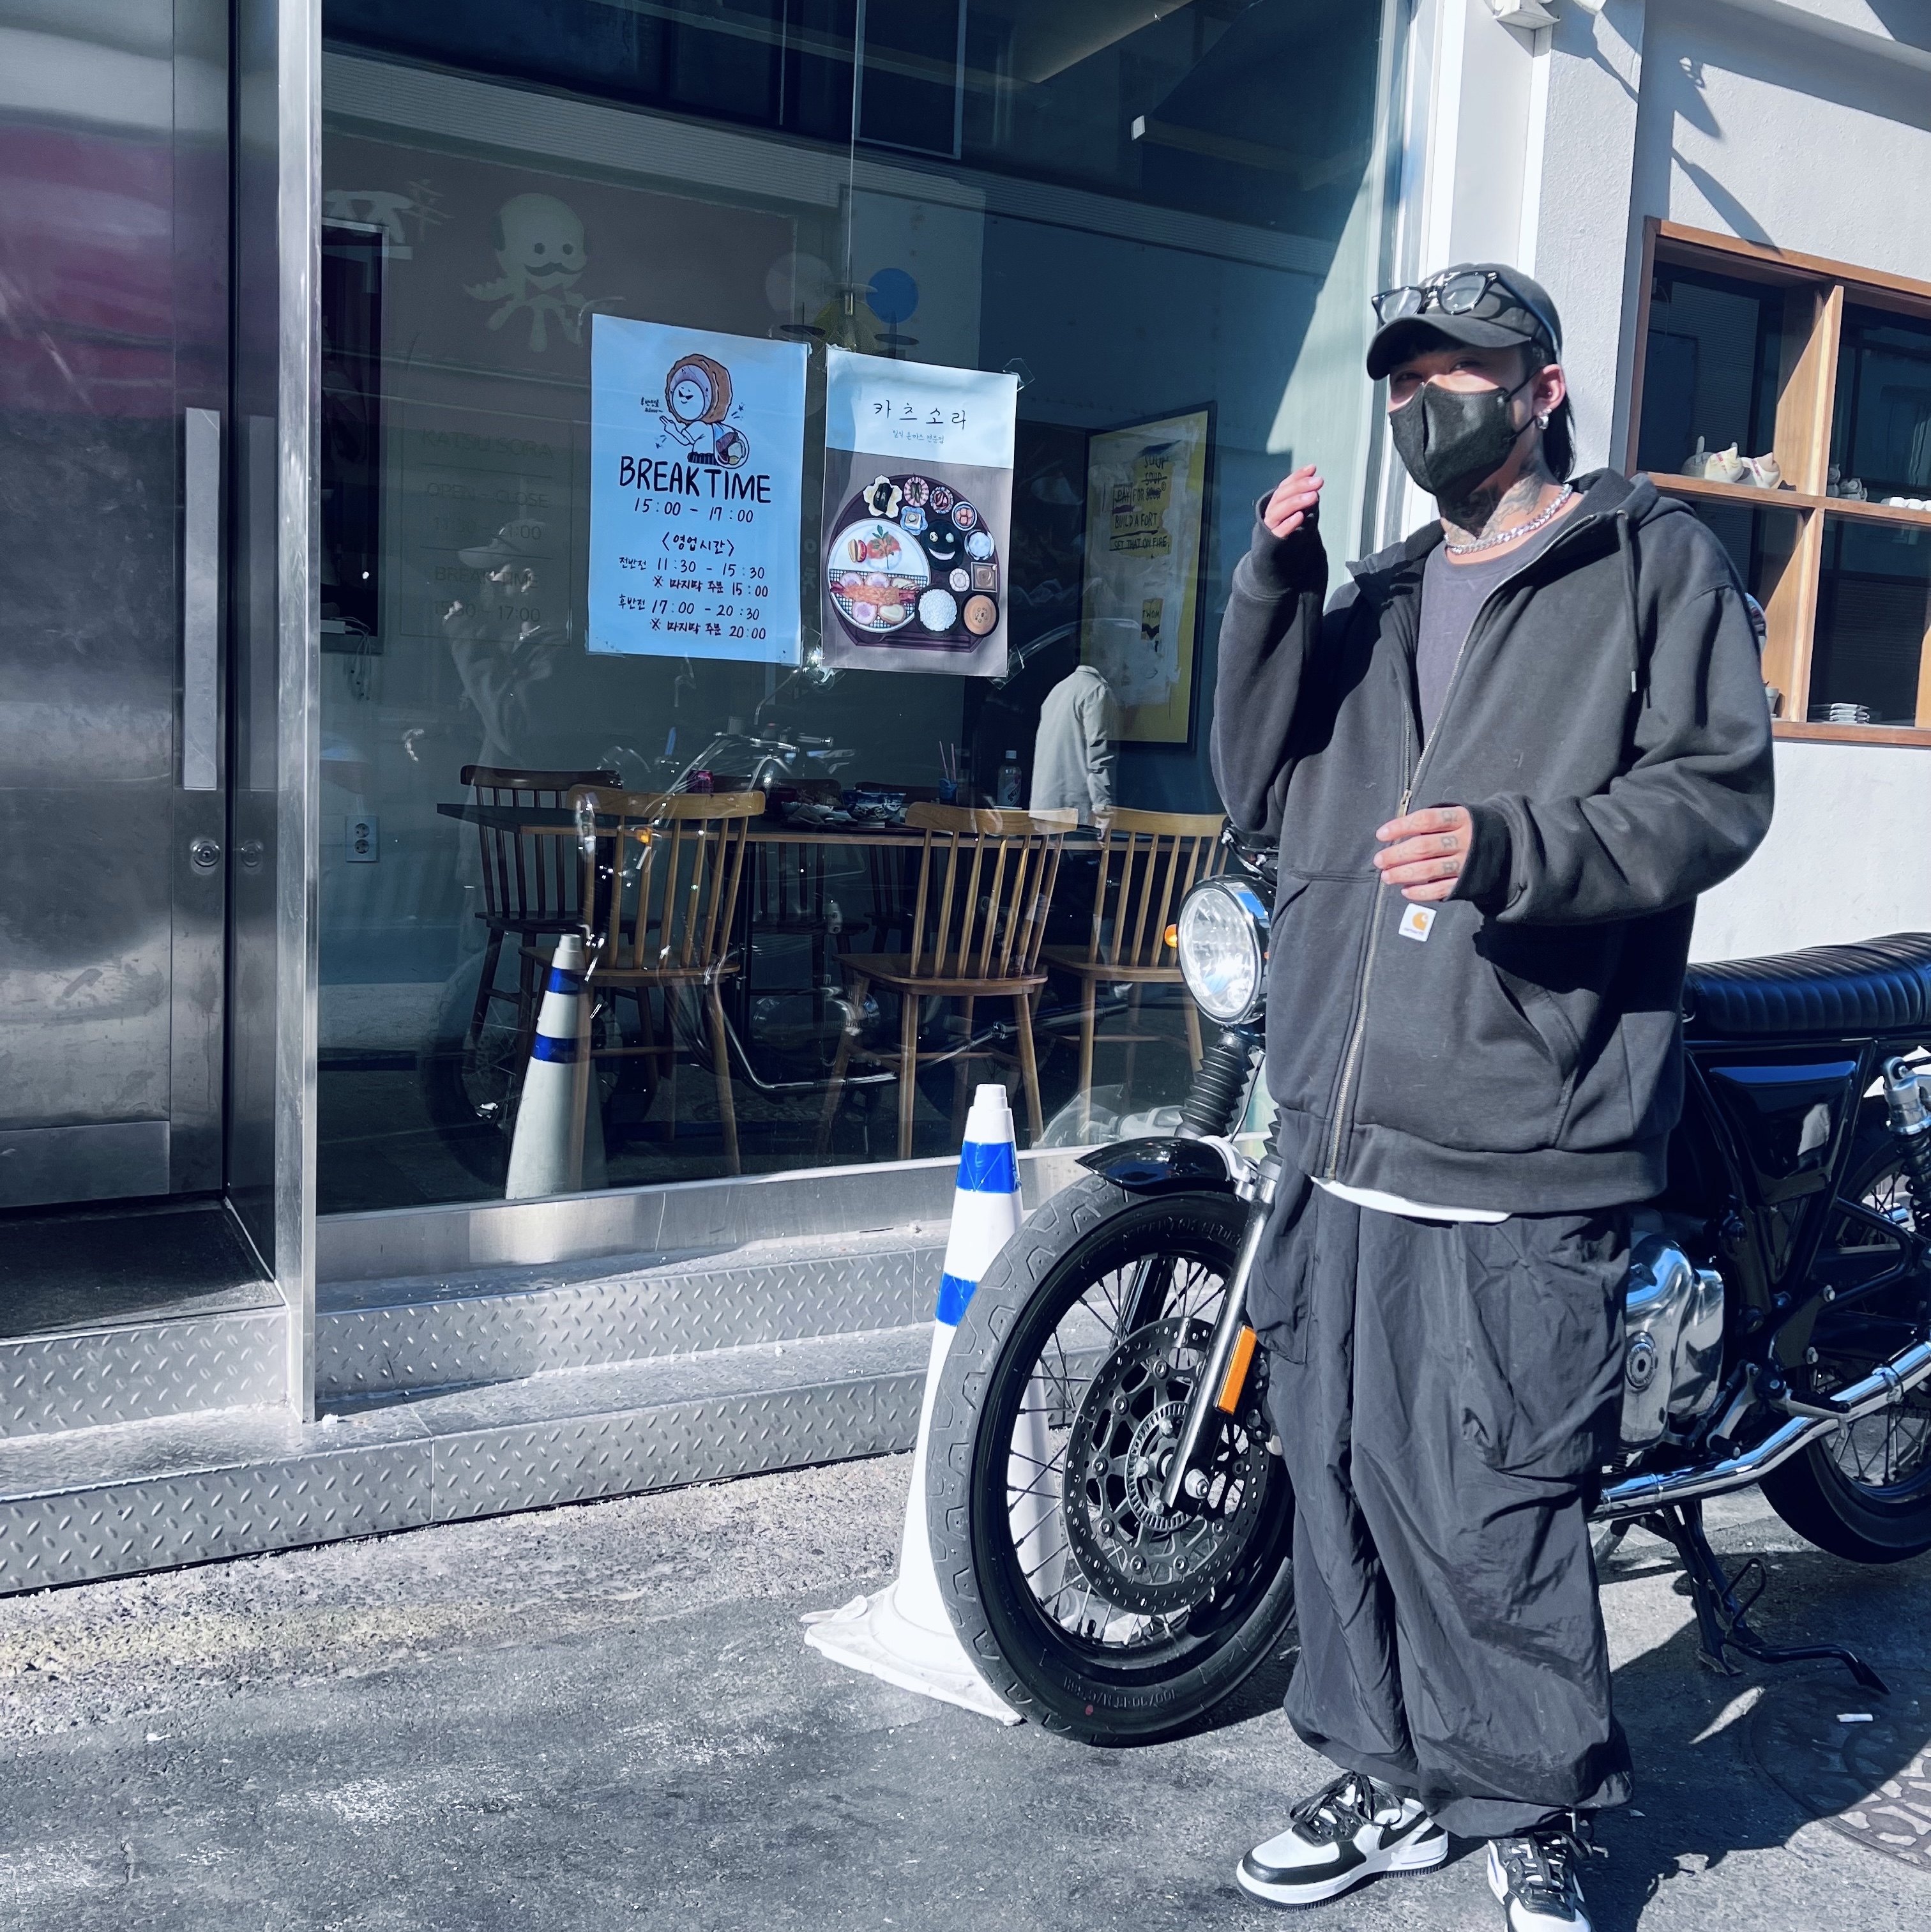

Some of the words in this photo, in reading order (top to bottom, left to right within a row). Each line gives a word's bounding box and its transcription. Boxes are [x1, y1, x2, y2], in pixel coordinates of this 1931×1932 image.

[892, 429, 904, 439] 일식
[926, 434, 944, 445] 전문점
[495, 437, 554, 459] SORA
[619, 455, 700, 498] BREAK
[704, 468, 772, 503] TIME
[496, 489, 549, 508] CLOSE
[1132, 488, 1144, 502] FOR
[635, 498, 681, 516] 15:00
[709, 506, 754, 523] 17:00
[1115, 514, 1133, 529] BUILD
[1134, 513, 1139, 527] A
[618, 556, 647, 570] 전반전
[657, 557, 697, 573] 11:30
[722, 563, 765, 579] 15:30
[707, 580, 724, 594] 주문
[732, 582, 769, 597] 15:00
[499, 605, 541, 623] 17:00
[617, 594, 646, 611] 후반전
[651, 599, 695, 614] 17:00
[716, 604, 760, 620] 20:30
[704, 622, 722, 636] 주문
[729, 625, 766, 639] 20:00
